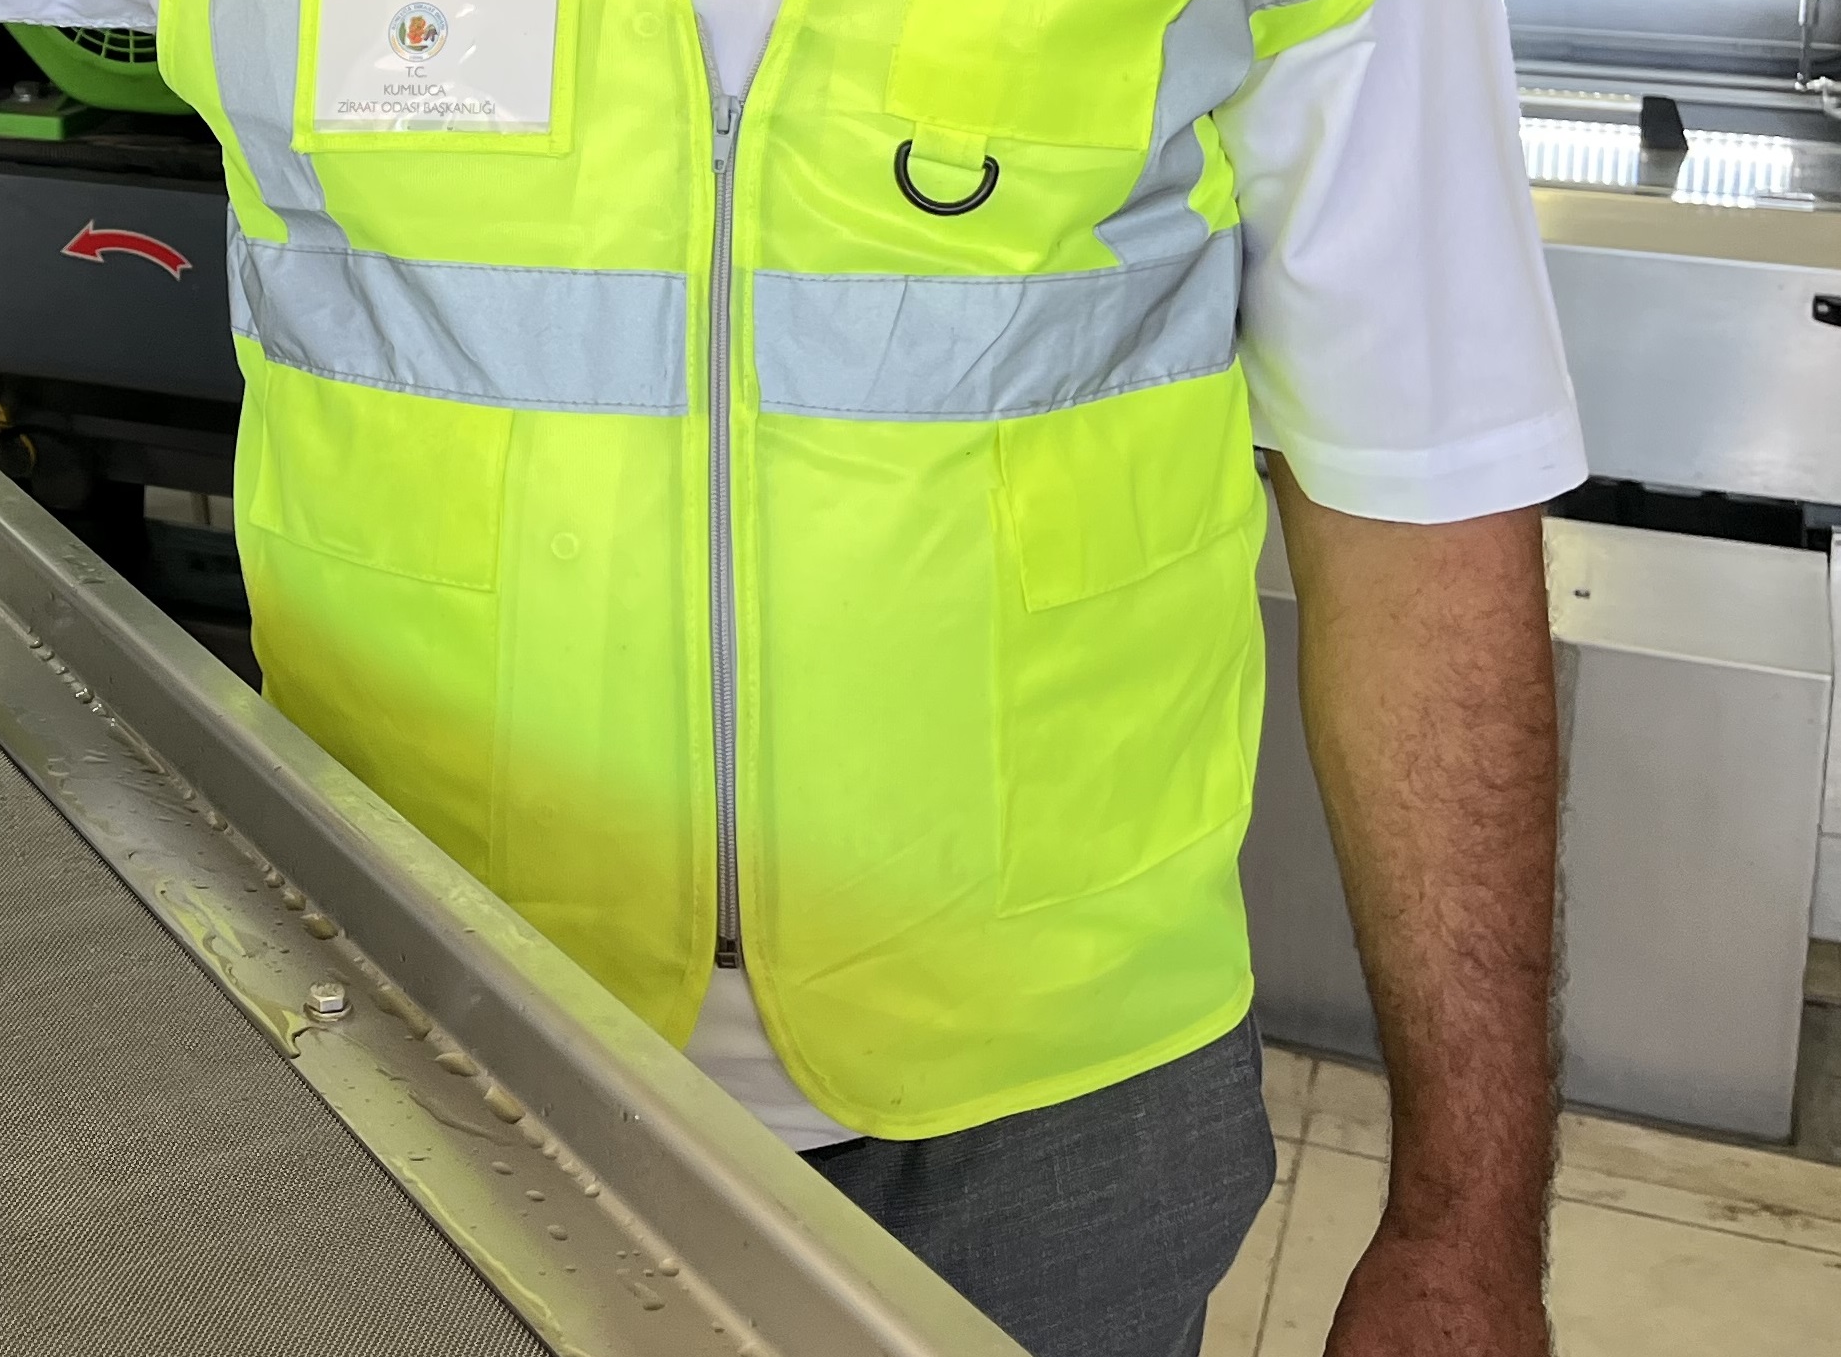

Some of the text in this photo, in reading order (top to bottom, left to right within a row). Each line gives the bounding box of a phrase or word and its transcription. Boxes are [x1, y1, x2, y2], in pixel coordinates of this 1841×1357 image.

[406, 66, 428, 78] T.C.
[383, 84, 446, 97] KUMLUCA
[337, 98, 495, 117] ZİRAAT ODASI BAŞKANLIĞI
